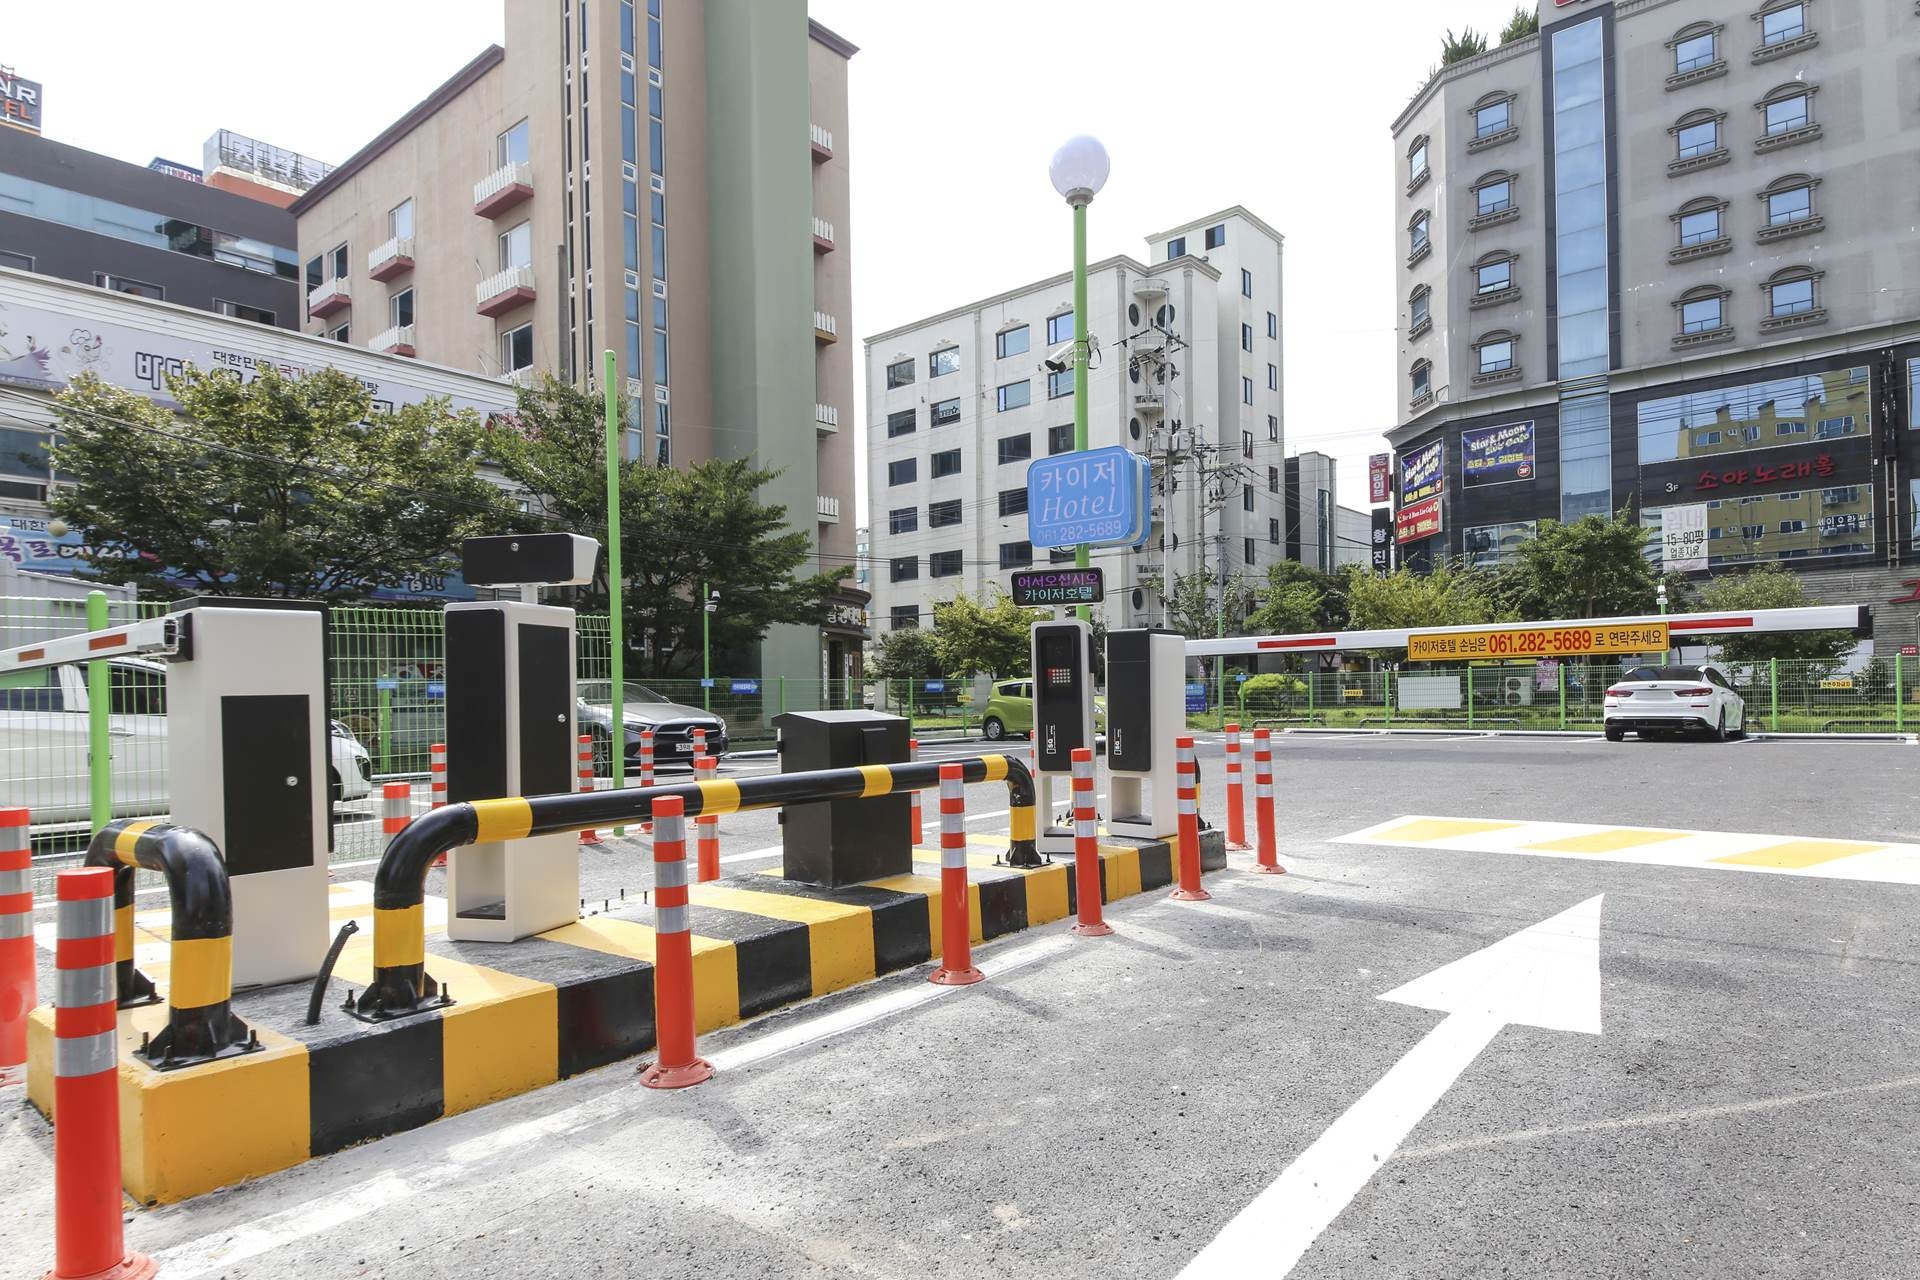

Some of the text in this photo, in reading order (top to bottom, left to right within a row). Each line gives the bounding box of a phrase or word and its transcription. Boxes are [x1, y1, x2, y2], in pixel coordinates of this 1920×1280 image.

[1040, 458, 1116, 494] 카이저
[1665, 482, 1679, 493] 3F
[1041, 486, 1116, 522] Hotel
[1018, 573, 1099, 588] 어서오십시오
[1025, 586, 1093, 602] 카이저호텔
[1413, 629, 1663, 655] 카이저호텔 손님은 061.282-5689 로 연락주세요
